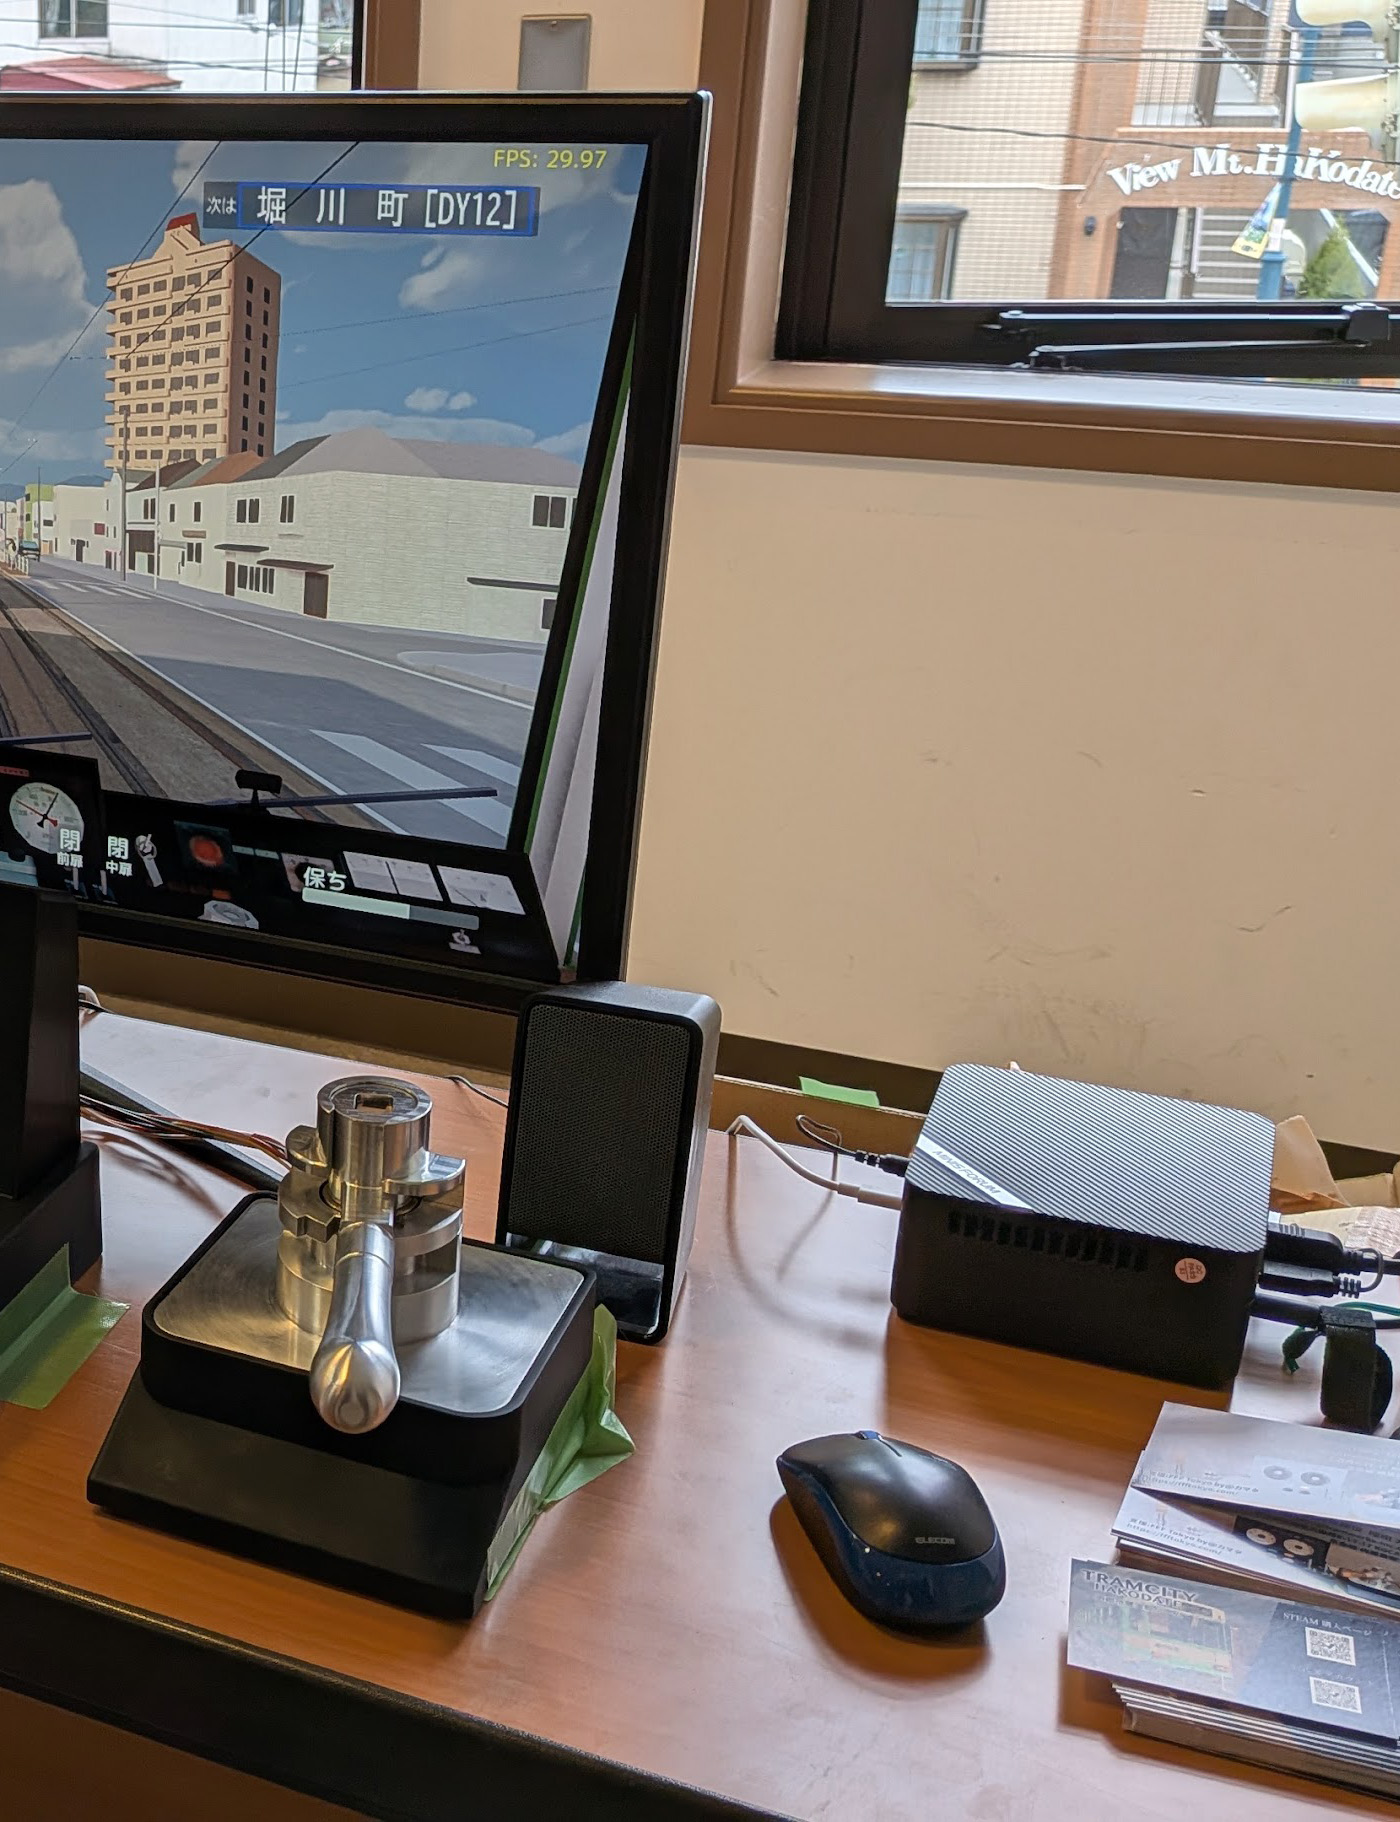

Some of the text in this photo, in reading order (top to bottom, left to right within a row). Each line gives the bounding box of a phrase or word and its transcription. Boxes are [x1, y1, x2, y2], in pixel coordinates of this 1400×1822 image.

[494, 150, 607, 169] FPS: 29.97
[1107, 157, 1182, 196] View
[206, 196, 237, 215] 次は
[425, 189, 517, 230] [DY12]
[59, 828, 81, 852] 閉
[107, 835, 129, 860] 閉
[105, 860, 133, 877] 中扉
[302, 865, 347, 892] 保ち
[915, 1536, 955, 1545] ELECOM
[1082, 1570, 1199, 1602] TRAMCITY
[1094, 1583, 1183, 1607] HAKODATE
[1283, 1612, 1319, 1626] STEAM
